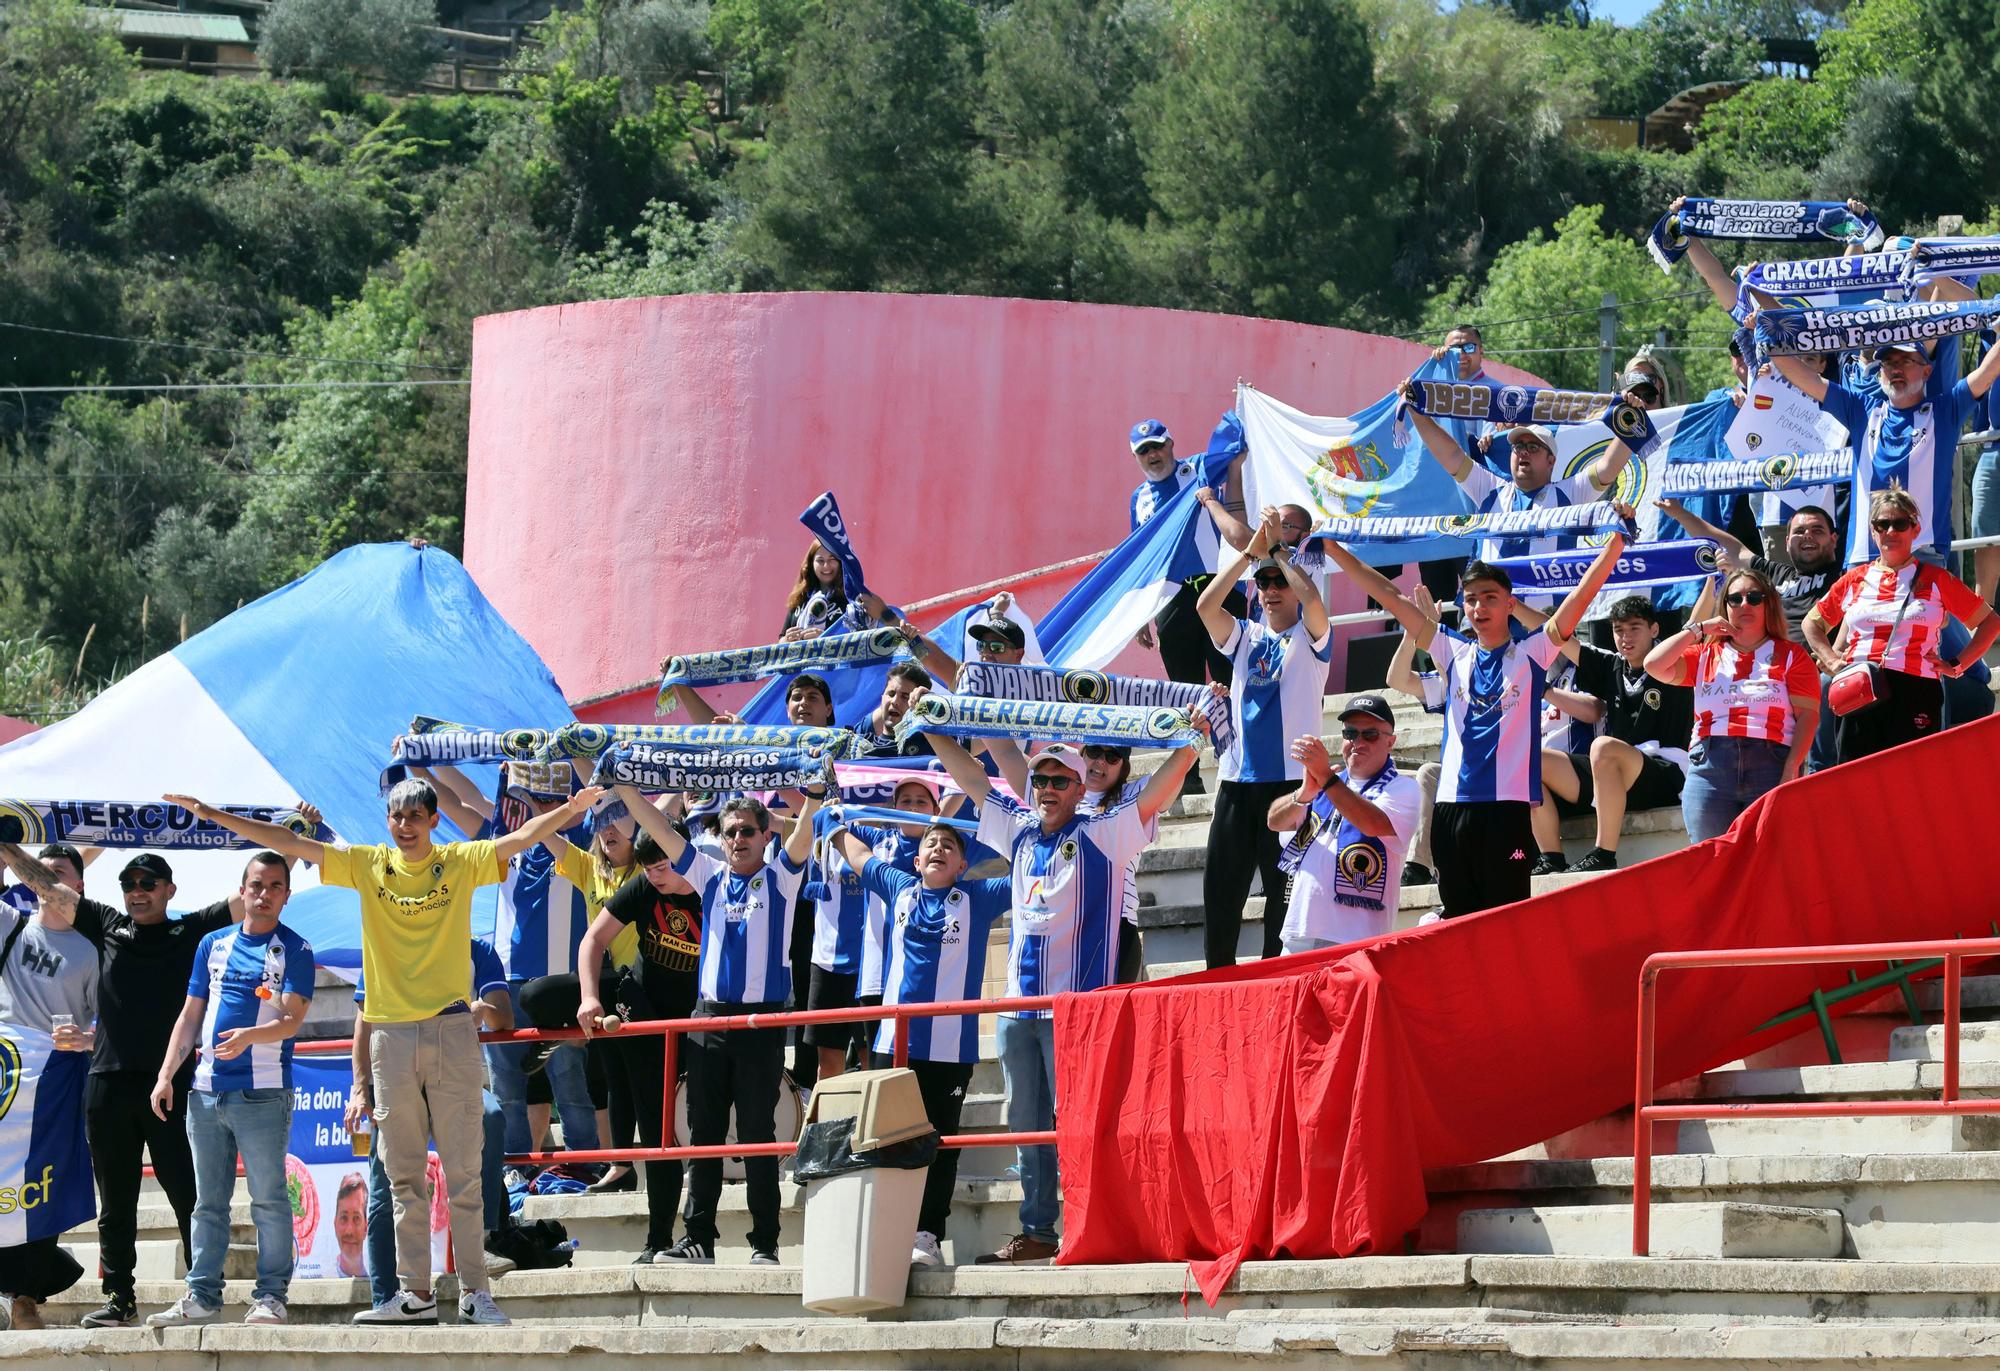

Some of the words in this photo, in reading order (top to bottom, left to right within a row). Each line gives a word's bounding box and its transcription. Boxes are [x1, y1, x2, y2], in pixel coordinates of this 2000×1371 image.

[1696, 201, 1807, 219] Herculanos
[1682, 215, 1715, 231] Sin
[1721, 218, 1815, 235] Fronteras
[1762, 257, 1852, 282] GRACIAS
[1785, 281, 1807, 290] SER
[1809, 280, 1829, 288] DEL
[1831, 275, 1890, 287] HERCULES
[1803, 301, 1961, 330] Herculanos
[1796, 330, 1841, 352] Sin
[1845, 313, 1979, 348] Fronteras
[1421, 381, 1492, 418] 1922
[1530, 556, 1647, 581] hérces
[958, 699, 1116, 730] HERCULES
[612, 724, 794, 747] HERCULES
[630, 743, 780, 768] Herculanos
[615, 761, 662, 788] Sin
[667, 768, 797, 790] Fronteras
[51, 800, 276, 842] HERCUS
[92, 829, 136, 843] club
[142, 831, 168, 844] de
[174, 832, 233, 846] fútbol
[661, 936, 680, 948] MAN
[680, 943, 700, 953] CITY
[21, 943, 64, 978] HH
[313, 1086, 342, 1110] don
[315, 1122, 329, 1147] la
